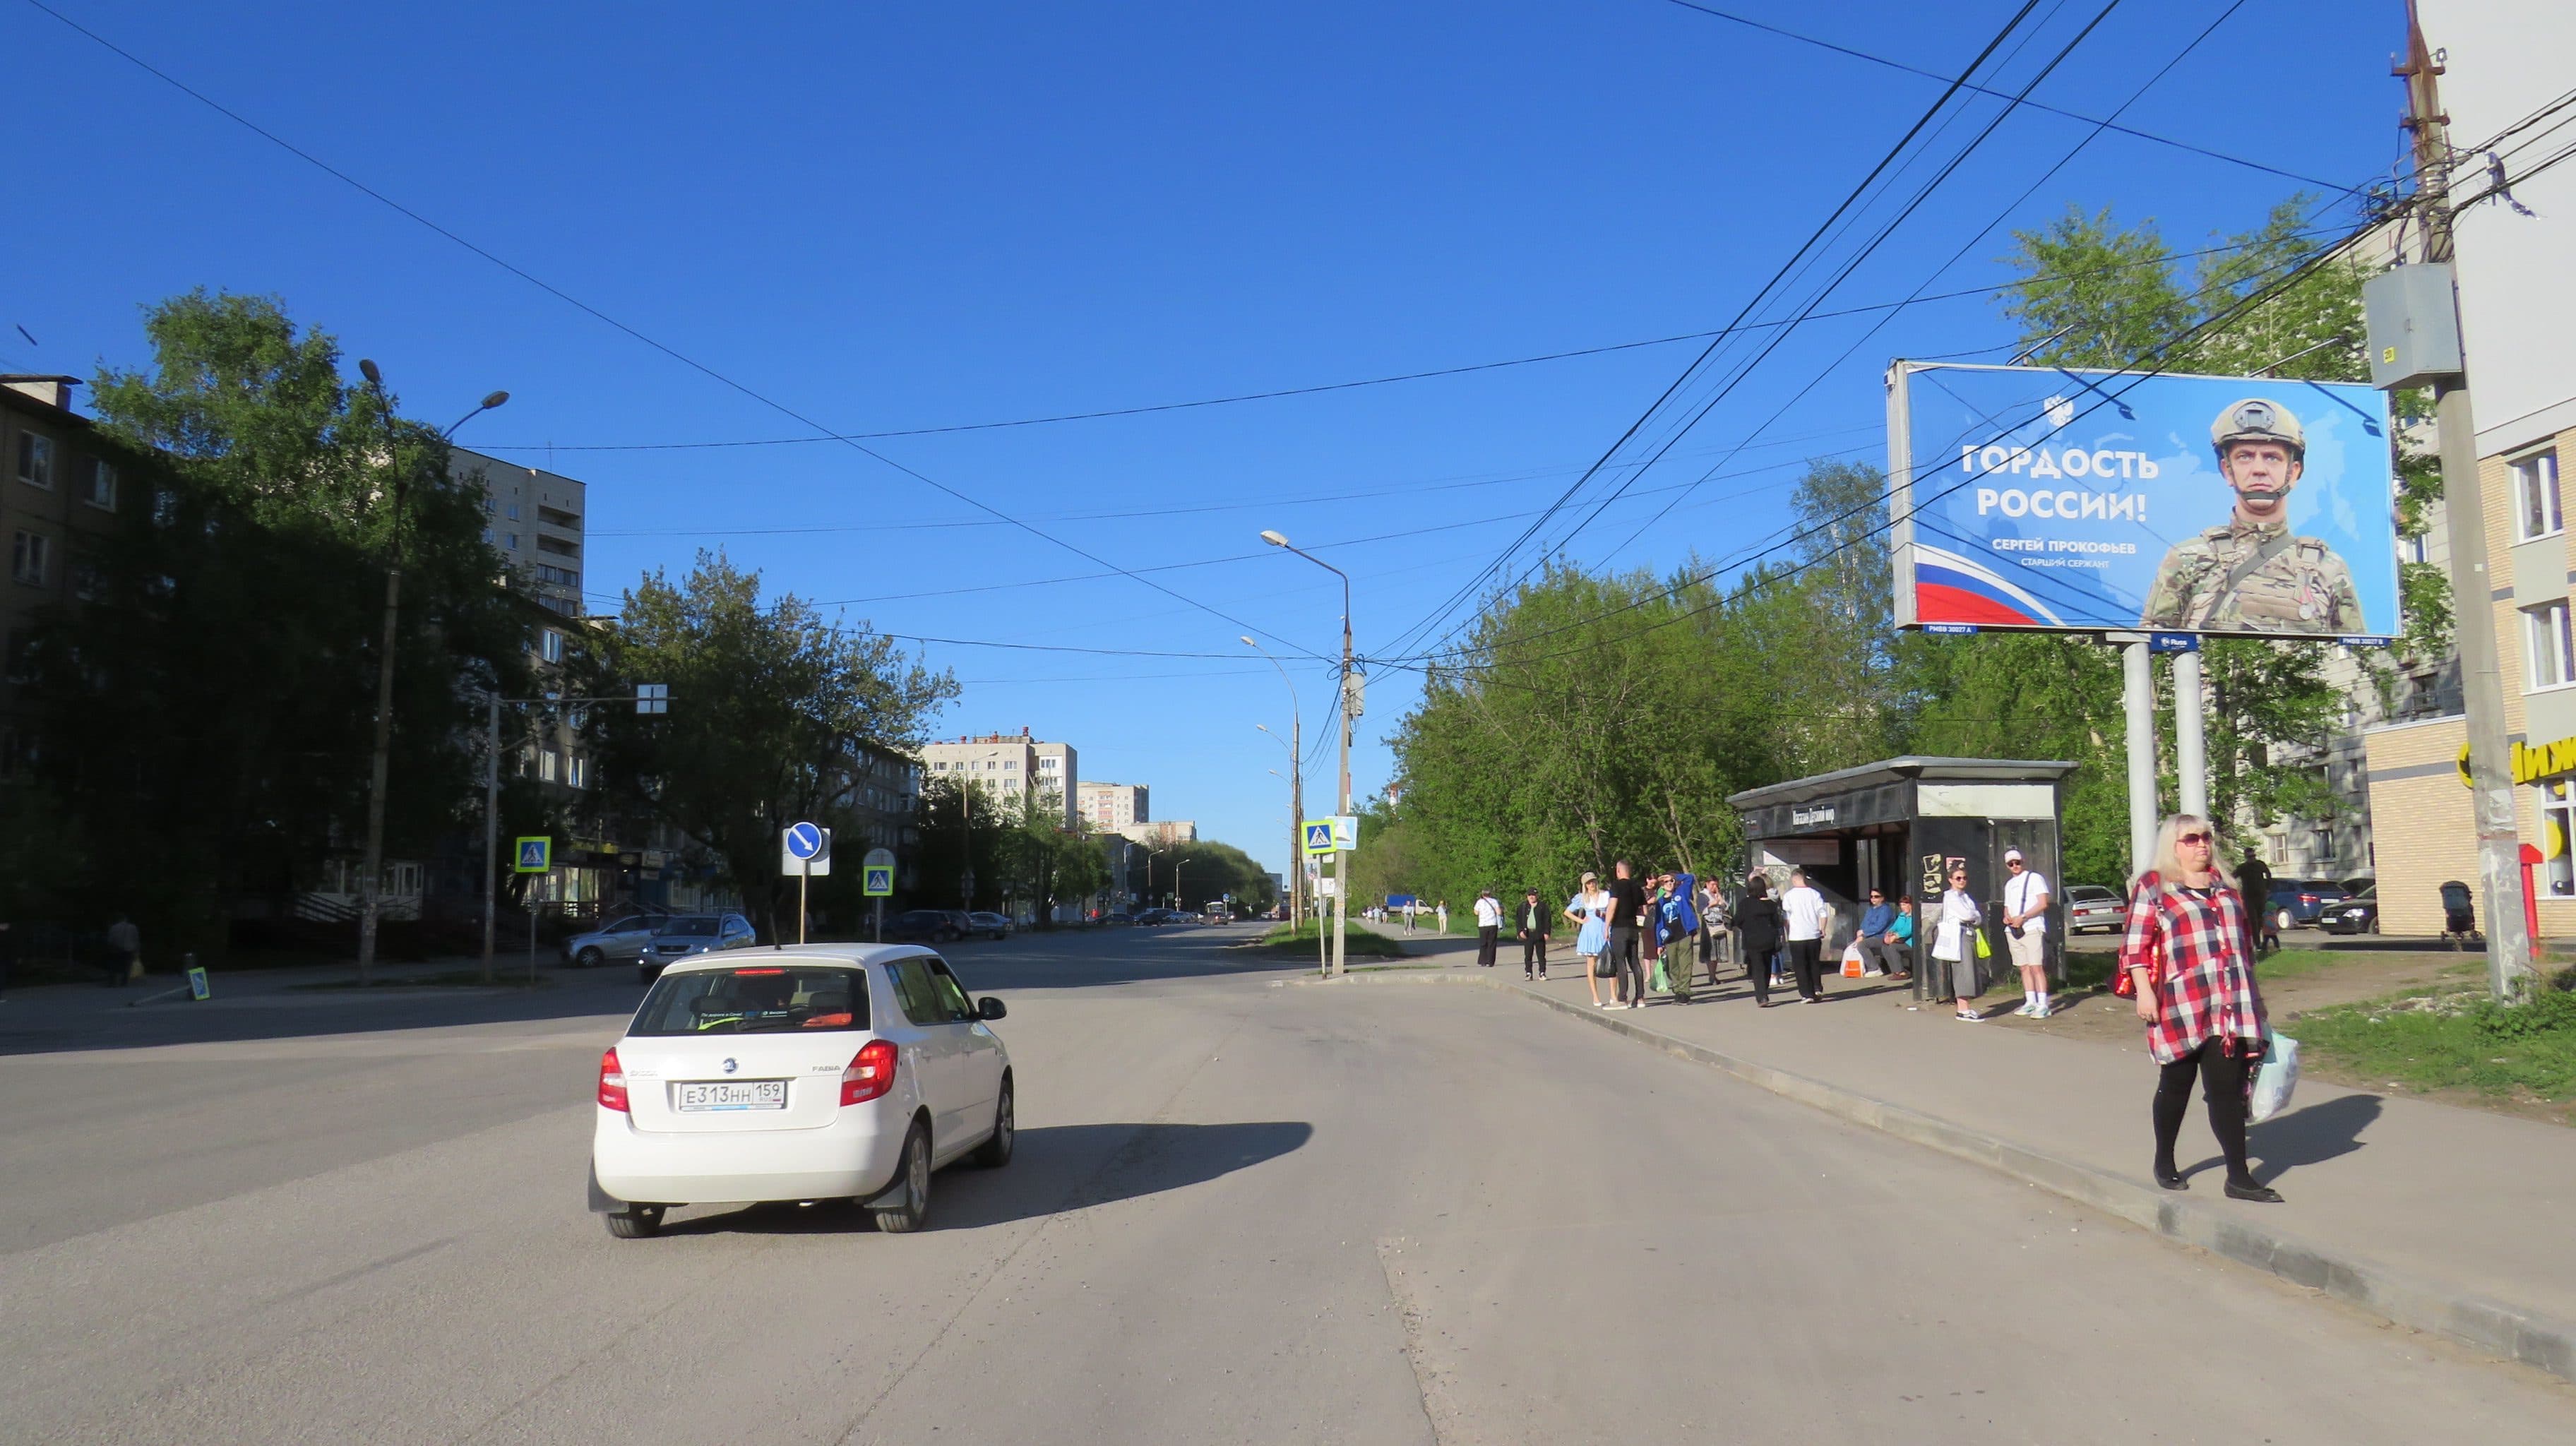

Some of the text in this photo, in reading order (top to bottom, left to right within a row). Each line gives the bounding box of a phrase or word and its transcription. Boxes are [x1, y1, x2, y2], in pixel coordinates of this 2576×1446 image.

[1962, 445, 2159, 479] ГОРДОСТЬ
[1976, 488, 2147, 522] РОССИИ!
[1991, 537, 2136, 554] СЕРГЕЙ ПРОКОФЬЕВ
[2020, 557, 2110, 569] СТАРШИЙ СЕРЖАНТ
[755, 1084, 780, 1097] 159
